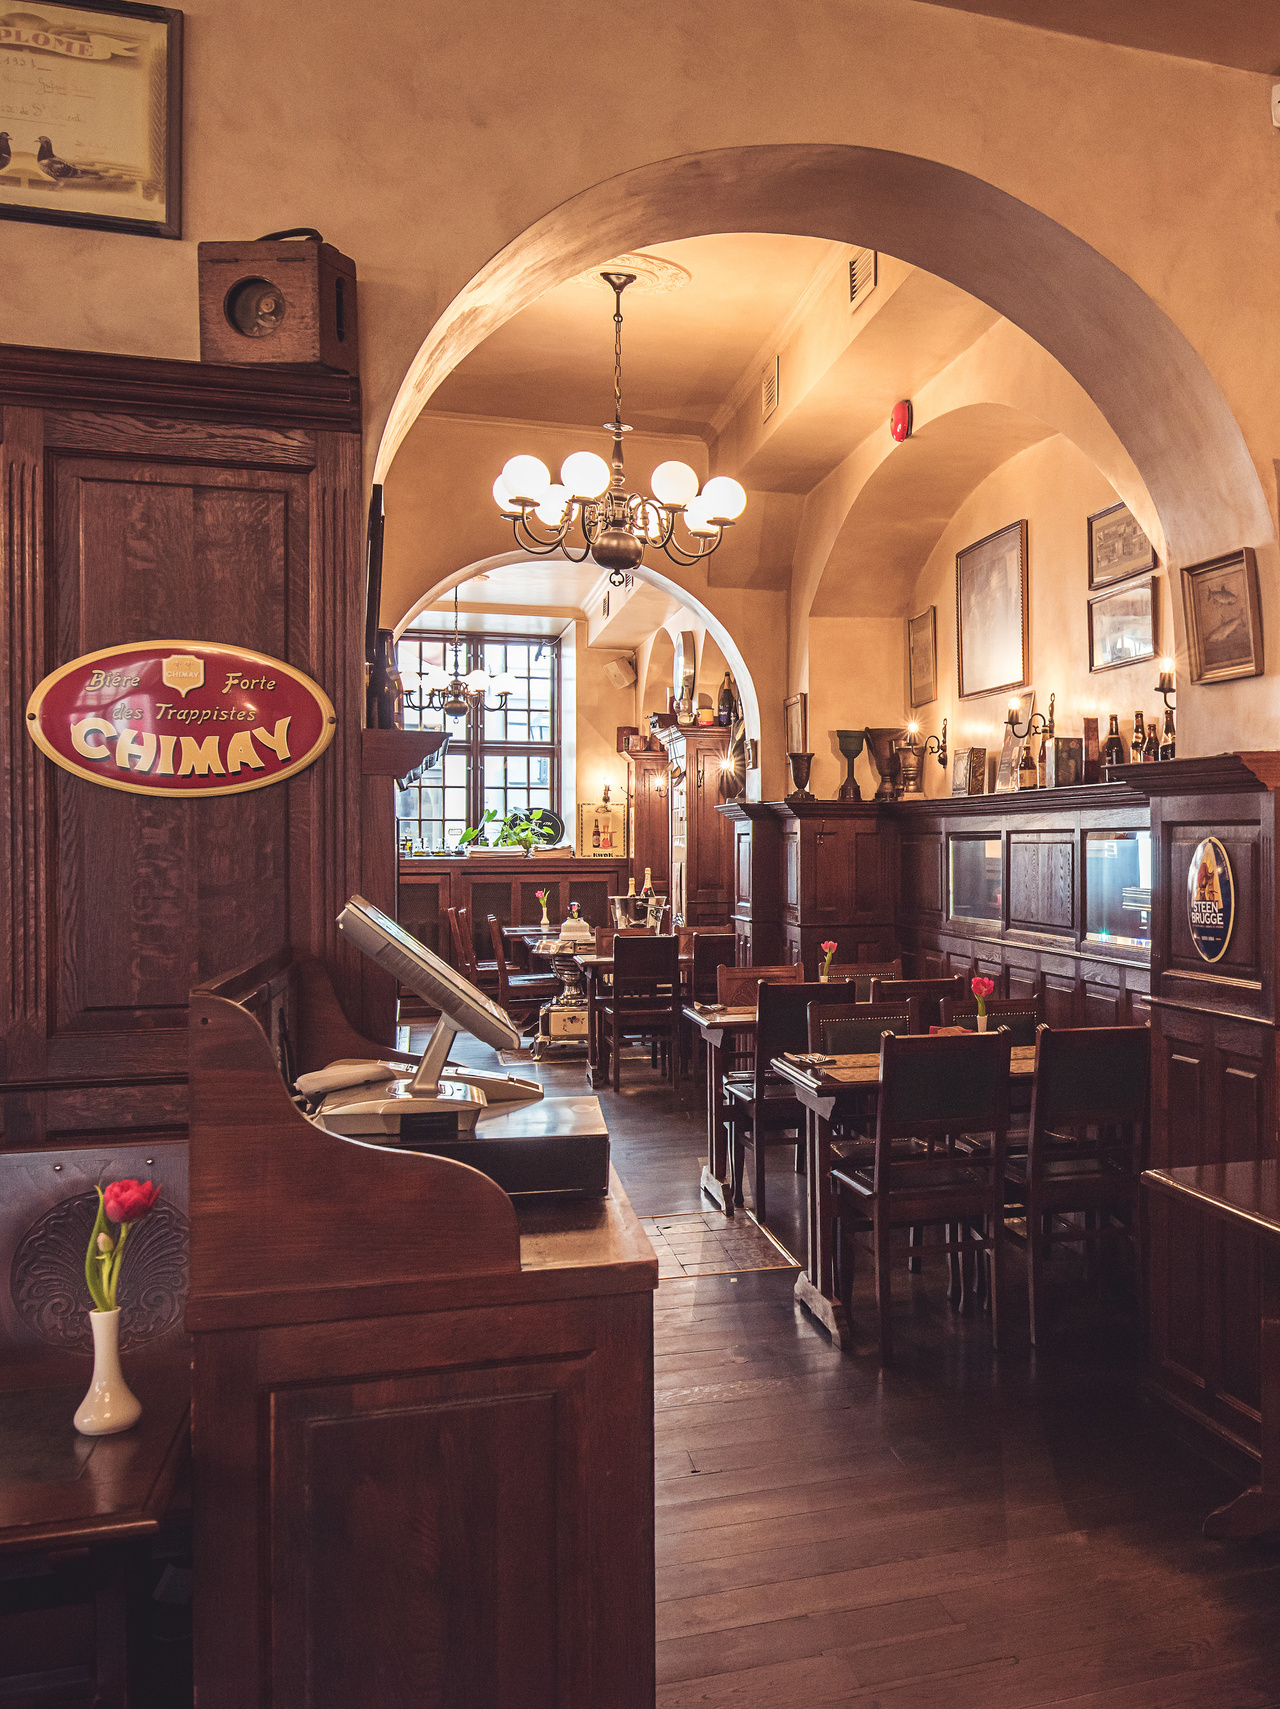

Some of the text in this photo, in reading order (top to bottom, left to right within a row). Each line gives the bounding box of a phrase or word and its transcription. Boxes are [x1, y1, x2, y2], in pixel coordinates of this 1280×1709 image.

[85, 669, 276, 693] Bière Forte
[112, 703, 256, 724] des Trappistes
[70, 716, 292, 777] CHIMAY
[1193, 901, 1219, 913] STEEN
[1191, 912, 1224, 925] BRUGGE
